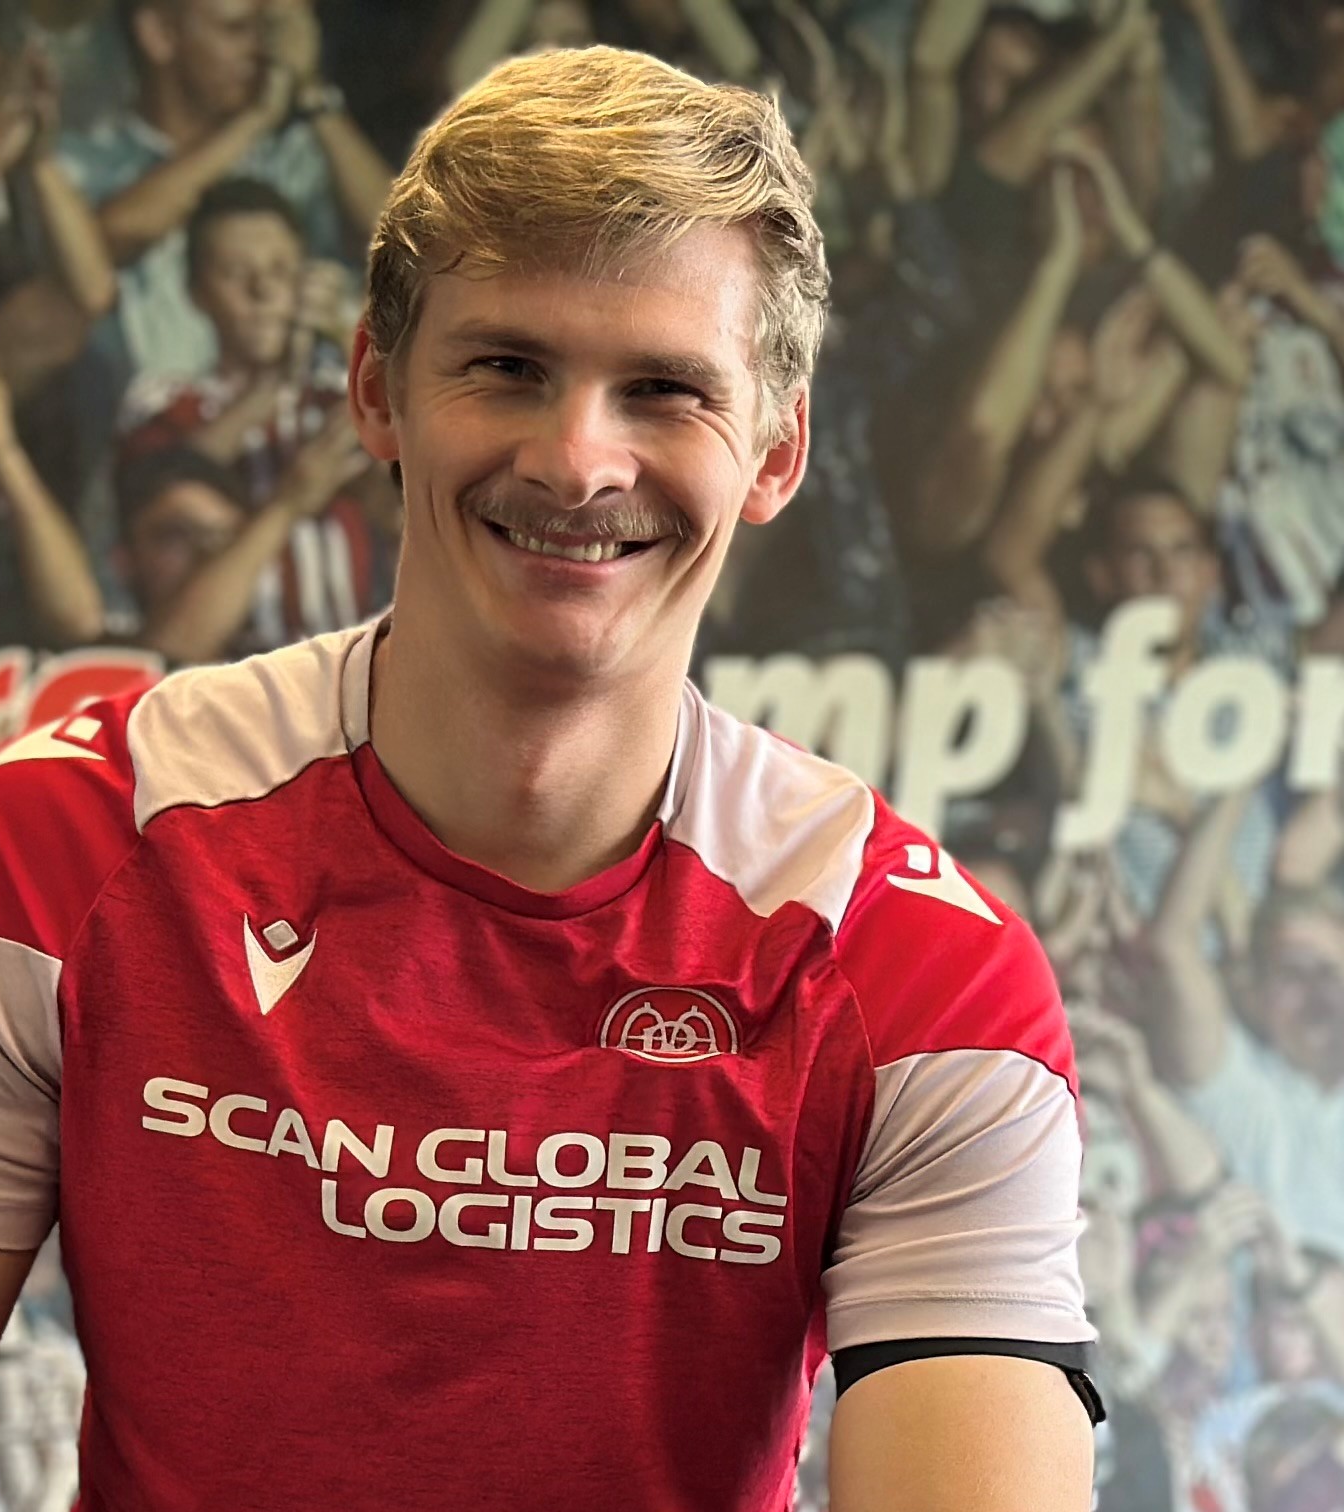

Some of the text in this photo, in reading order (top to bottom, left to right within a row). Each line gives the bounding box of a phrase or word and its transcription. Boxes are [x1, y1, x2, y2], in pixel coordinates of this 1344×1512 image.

[141, 1075, 788, 1208] SCAN GLOBAL
[321, 1179, 786, 1264] LOGISTICS
